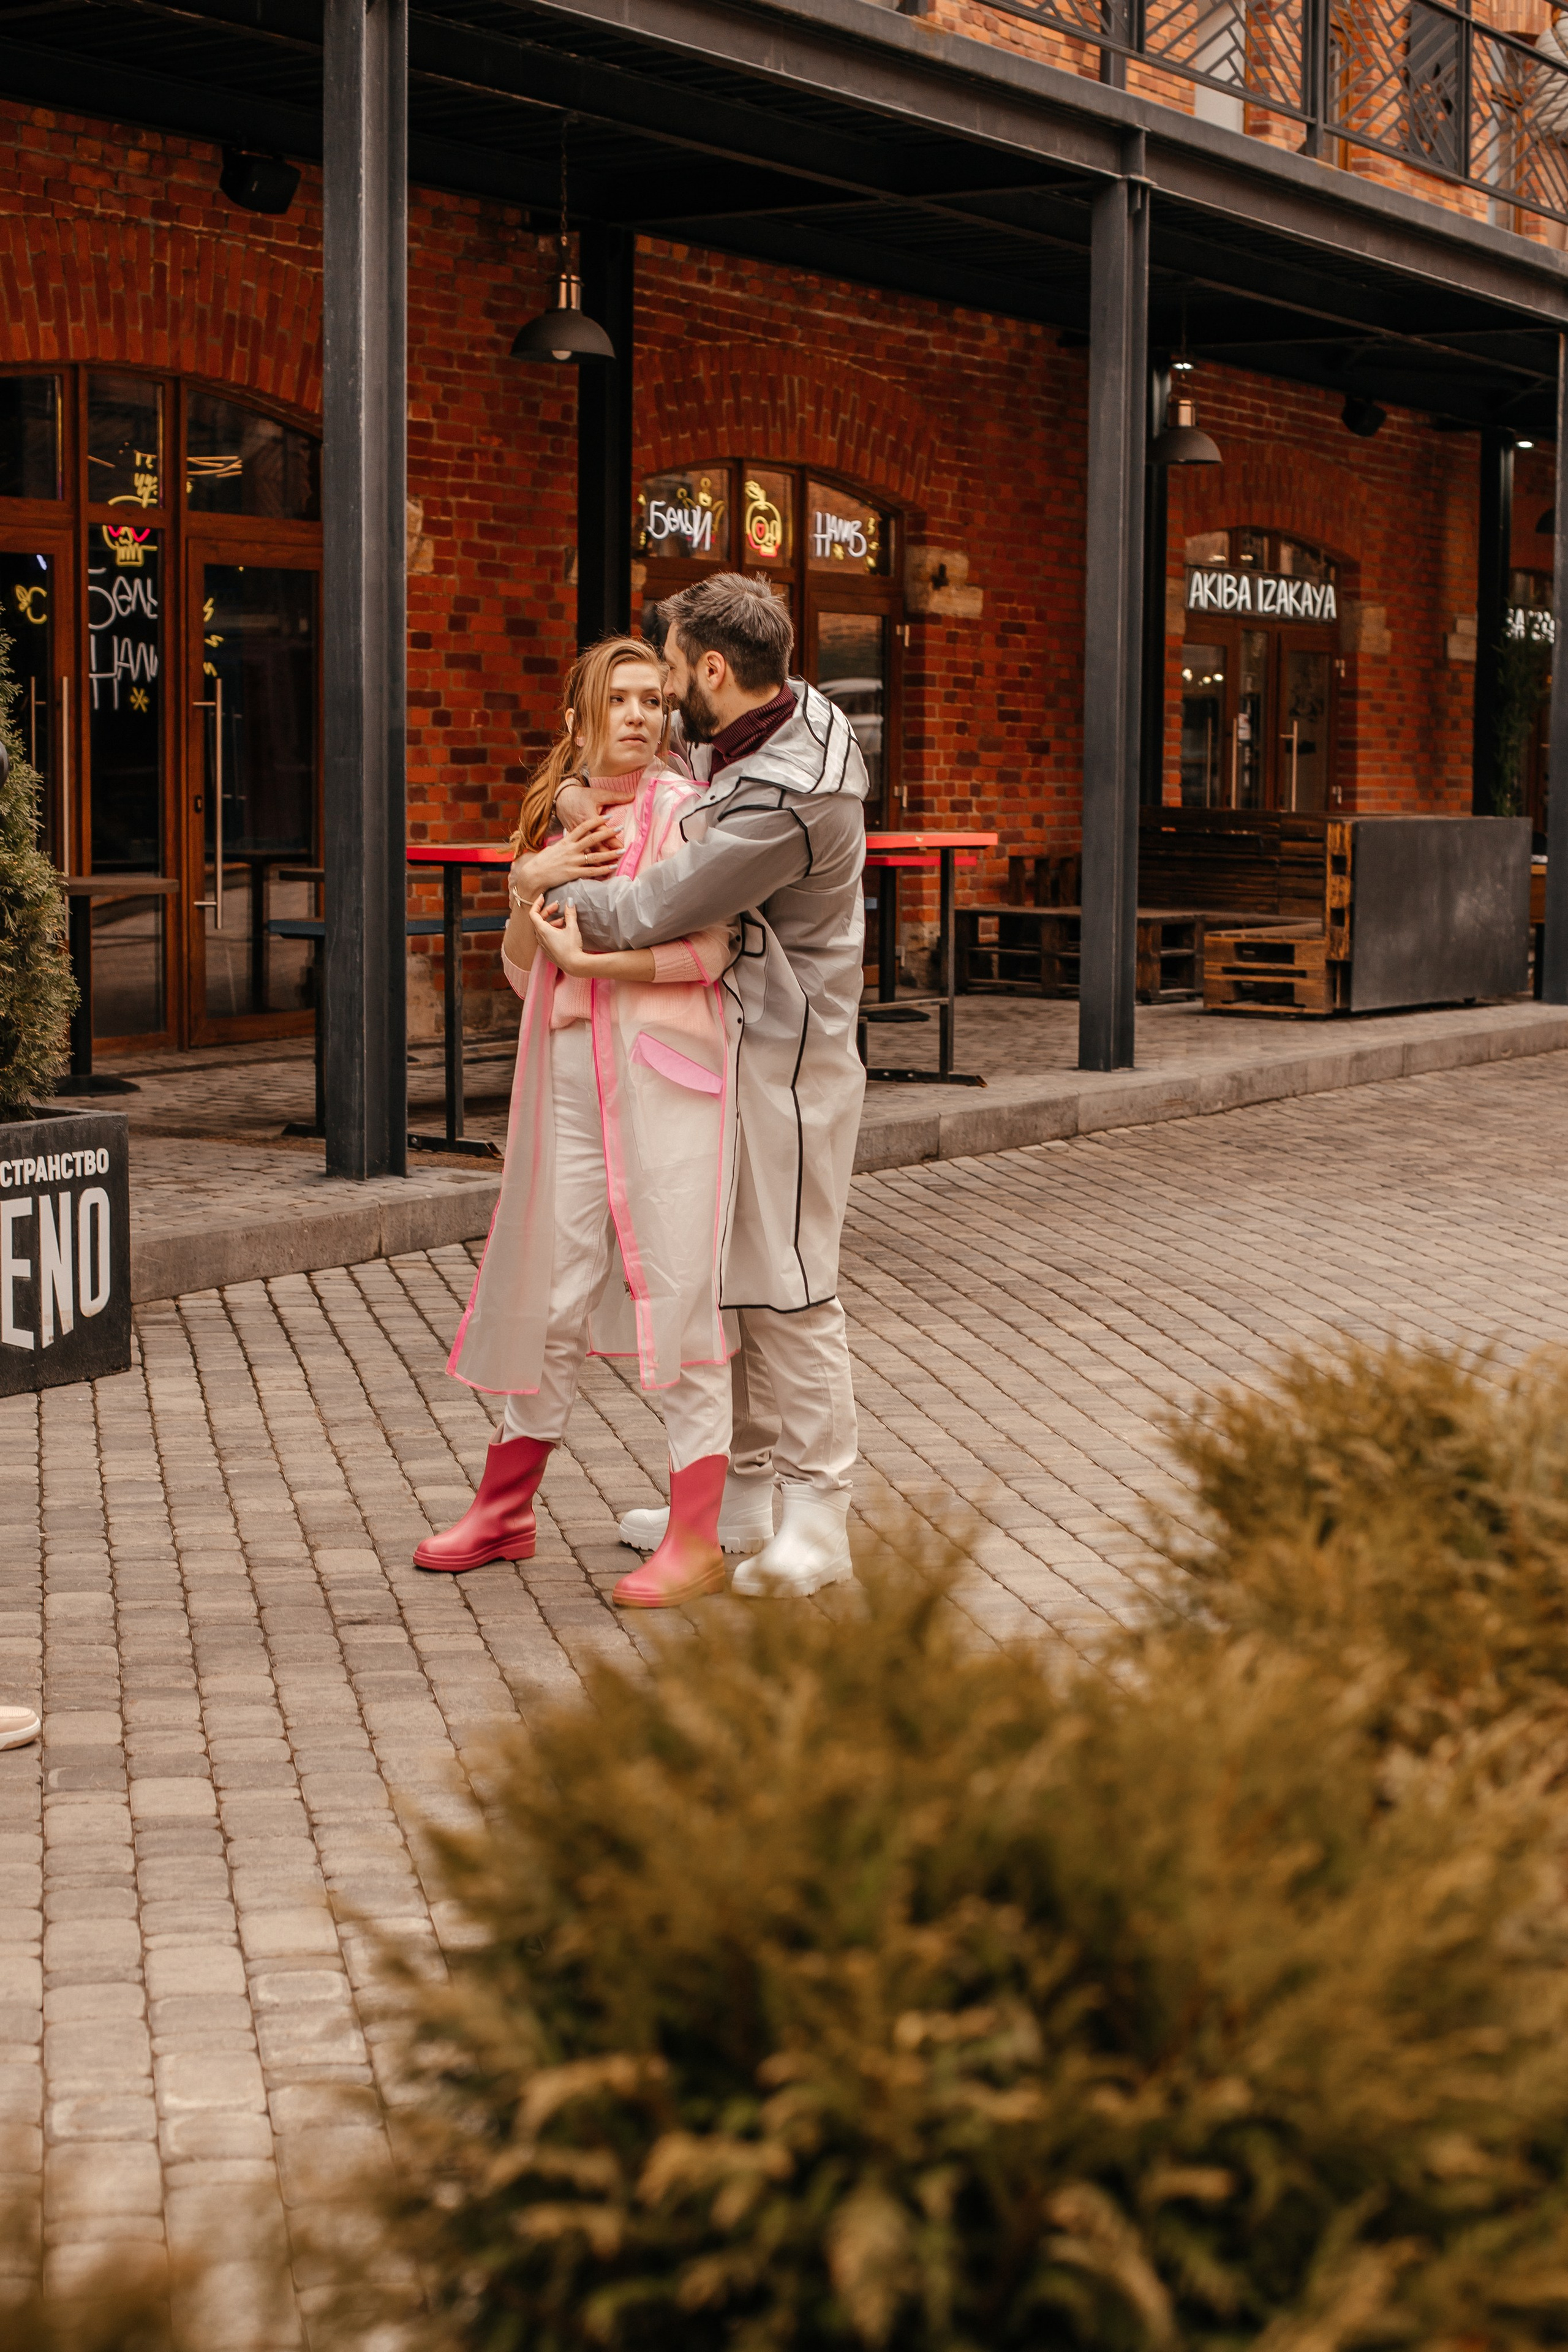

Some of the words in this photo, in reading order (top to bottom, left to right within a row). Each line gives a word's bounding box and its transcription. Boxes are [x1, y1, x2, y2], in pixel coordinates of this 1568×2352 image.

[1188, 570, 1251, 612] AKIBA
[1257, 577, 1337, 619] IZAKAYA
[0, 1148, 110, 1188] СТРАНСТВО
[1, 1187, 111, 1350] ENO
